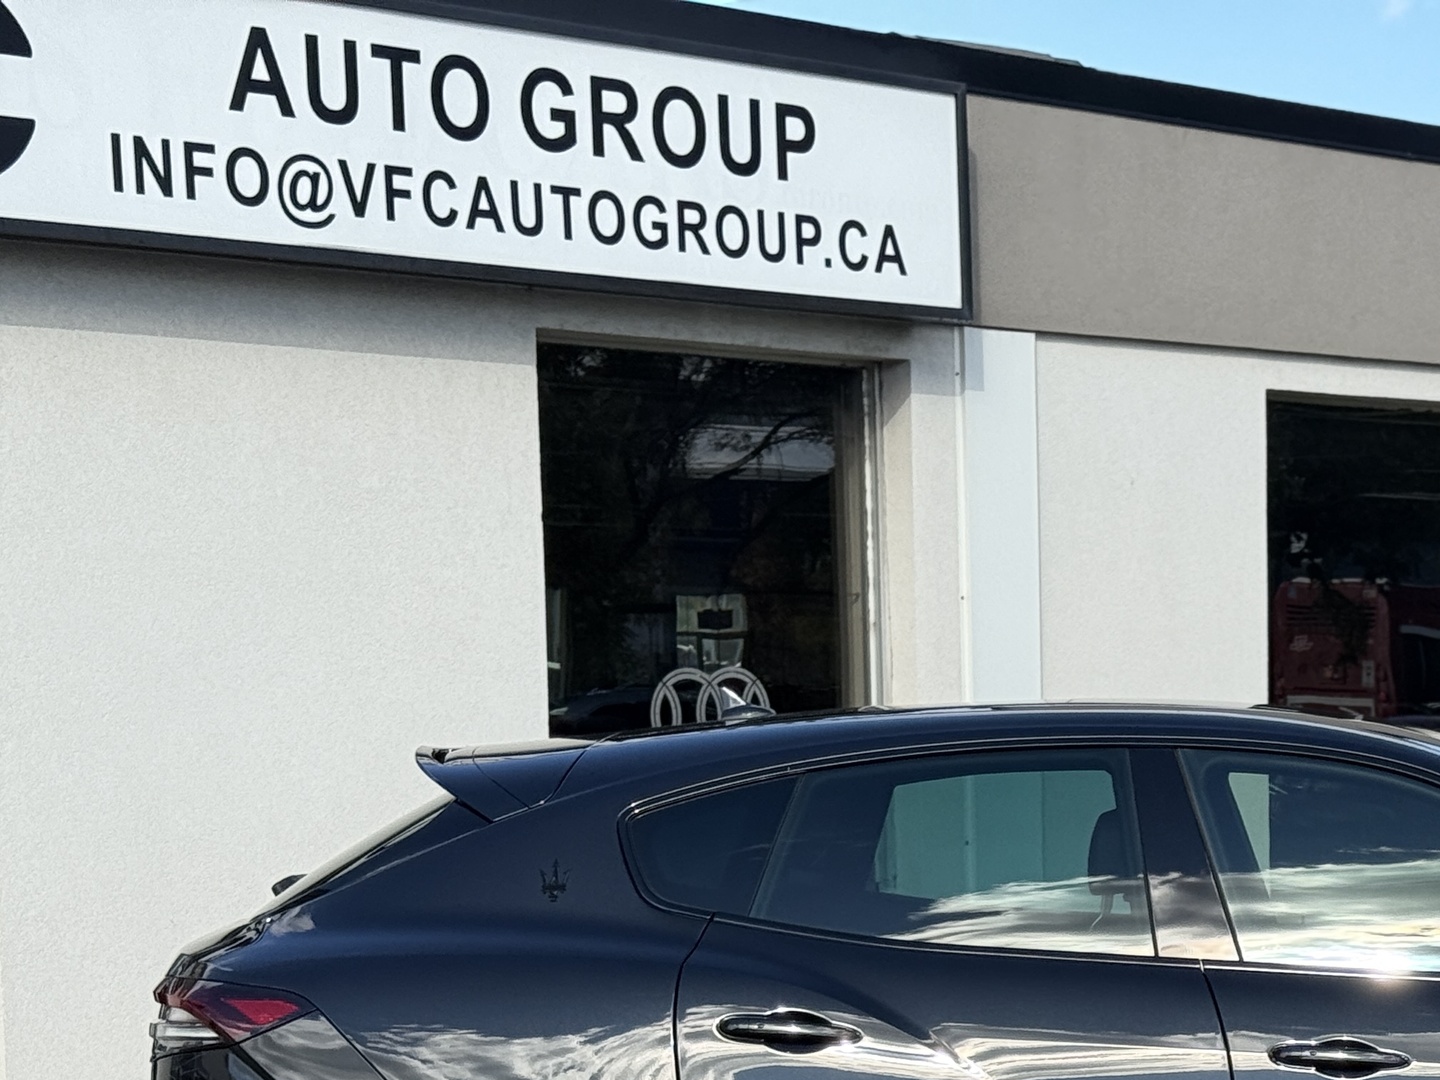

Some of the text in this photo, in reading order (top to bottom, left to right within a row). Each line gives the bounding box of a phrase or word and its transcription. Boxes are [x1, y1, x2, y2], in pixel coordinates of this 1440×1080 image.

[228, 26, 817, 182] AUTO GROUP
[110, 132, 907, 276] INFO@VFCAUTOGROUP.CA
